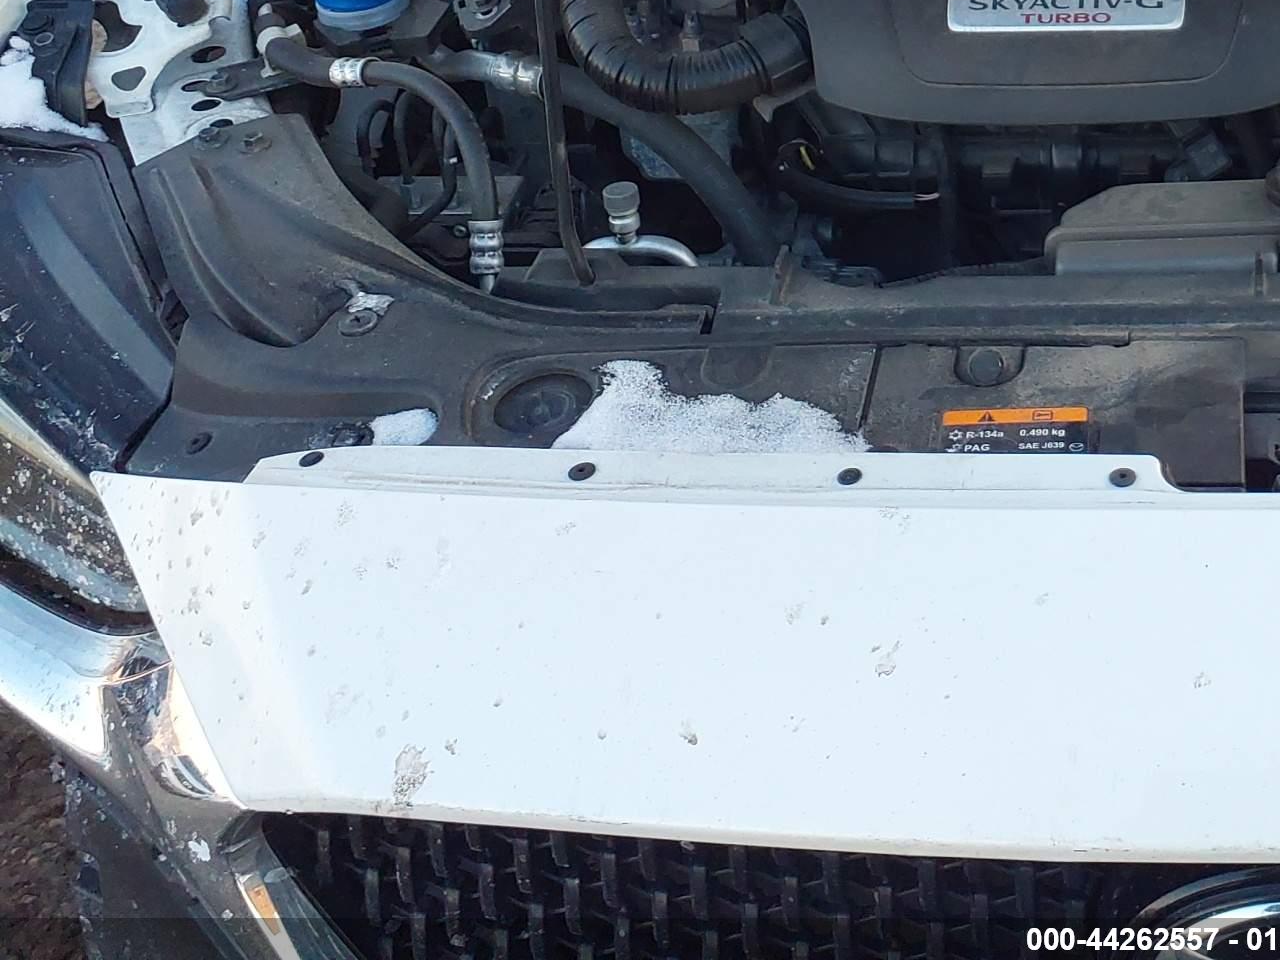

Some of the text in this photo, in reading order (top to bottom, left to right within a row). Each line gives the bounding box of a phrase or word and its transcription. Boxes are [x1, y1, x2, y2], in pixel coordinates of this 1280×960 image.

[1020, 12, 1112, 25] TURBO
[966, 430, 1005, 439] R-134a
[1019, 428, 1066, 438] 0.490 kg
[964, 443, 990, 452] PAG
[1018, 442, 1039, 450] SAE
